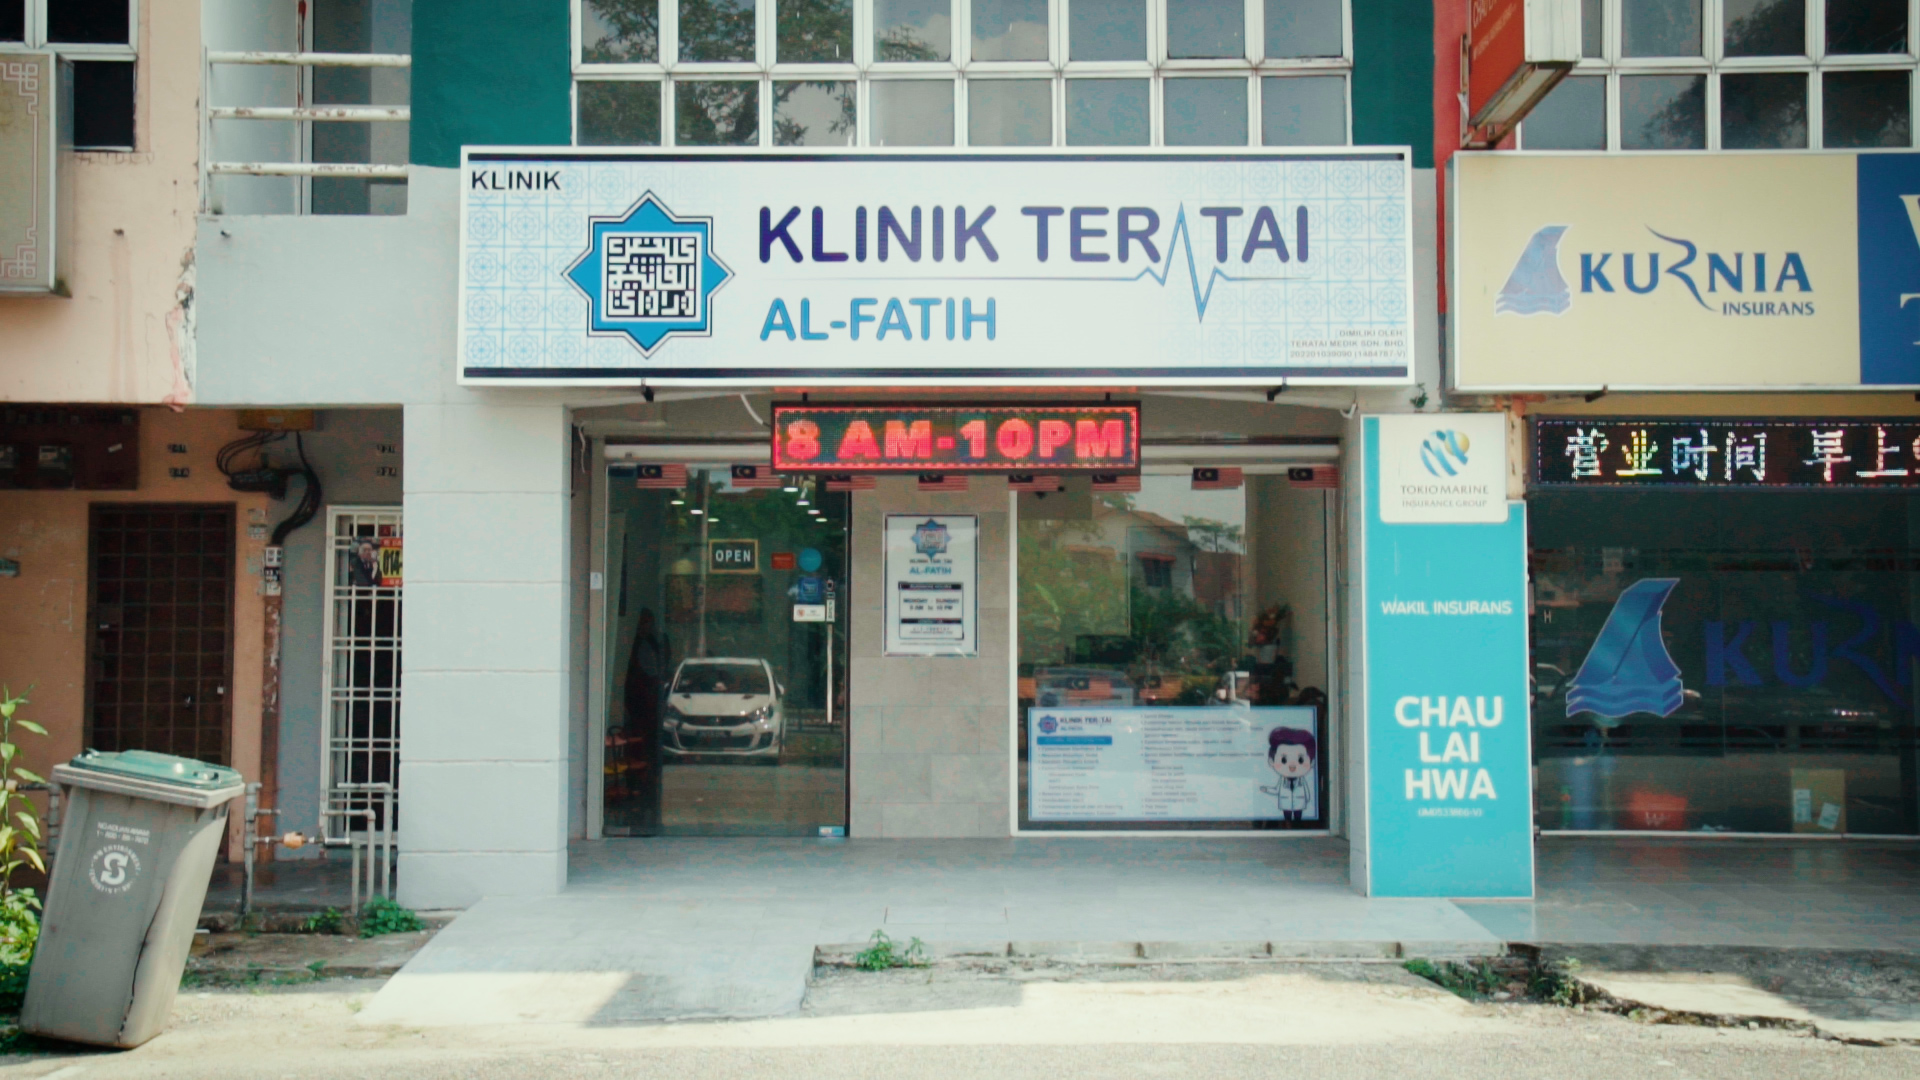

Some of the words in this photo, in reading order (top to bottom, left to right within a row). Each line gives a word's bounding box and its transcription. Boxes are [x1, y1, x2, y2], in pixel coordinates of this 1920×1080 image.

[471, 170, 561, 191] KLINIK
[759, 205, 999, 263] KLINIK
[1580, 223, 1814, 313] KURNIA
[760, 296, 996, 341] AL-FATIH
[1722, 301, 1815, 317] INSURANS
[785, 418, 821, 460] 8
[837, 417, 1126, 461] AM-10PM
[1565, 428, 1767, 481] 营业时间
[1400, 485, 1438, 495] TOKIO
[1440, 485, 1489, 495] MARINE
[1402, 500, 1453, 508] INSURANCE
[1455, 500, 1488, 508] GROUP
[715, 550, 751, 562] OPEN
[1381, 601, 1428, 615] WAKIL
[1433, 601, 1512, 615] INSURANS
[1394, 695, 1503, 727] CHAU
[1419, 731, 1480, 763] LAI
[1404, 768, 1497, 799] HWA
